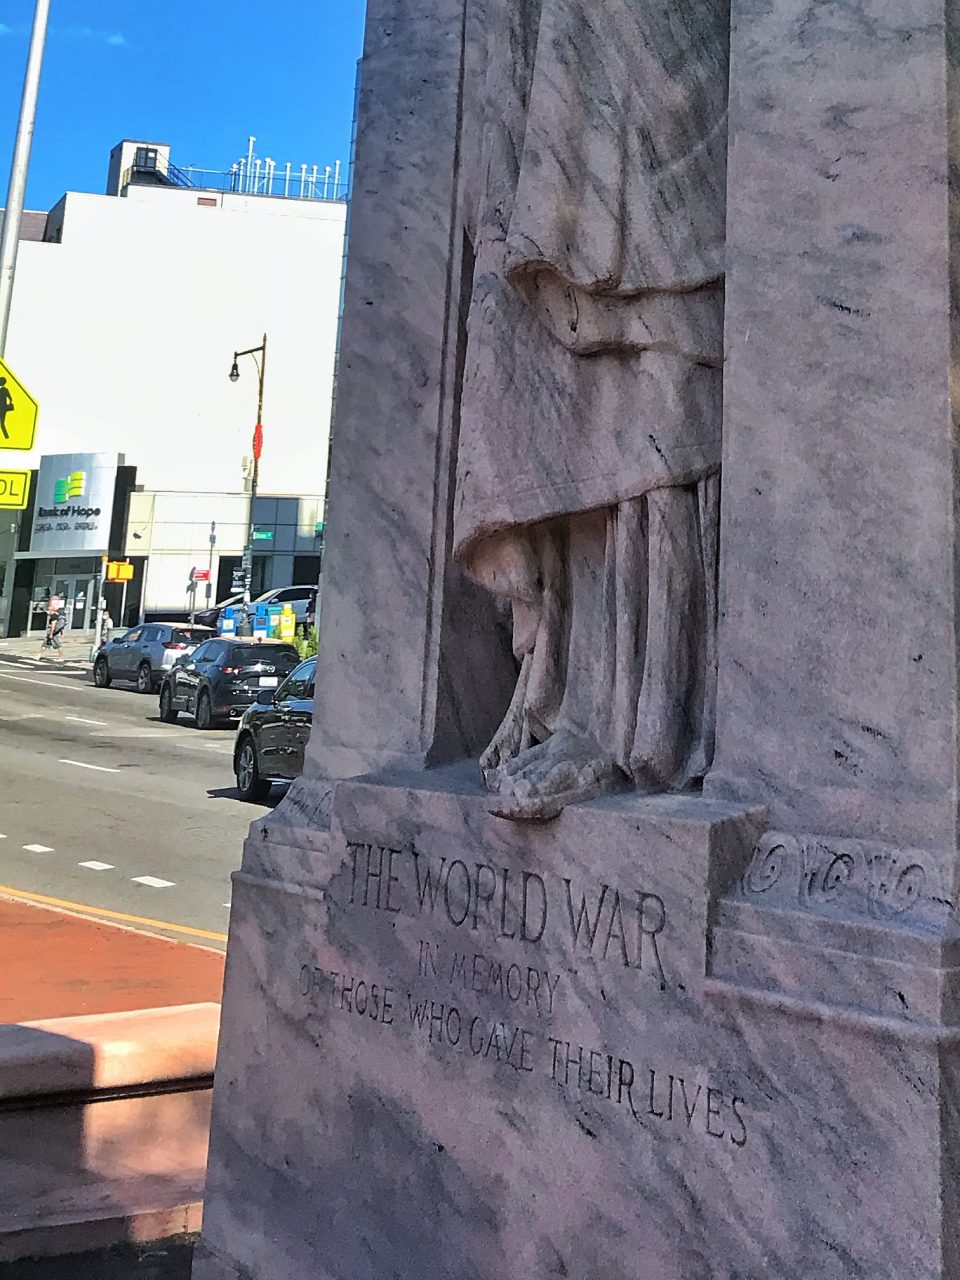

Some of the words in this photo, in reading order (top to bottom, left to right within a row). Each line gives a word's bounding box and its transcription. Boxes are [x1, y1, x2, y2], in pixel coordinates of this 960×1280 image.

[71, 506, 101, 519] Hope
[346, 841, 402, 913] THE
[411, 847, 548, 944] WORLD
[562, 877, 672, 991] WAR
[418, 939, 439, 976] IN
[449, 951, 560, 1016] MEMORY
[299, 963, 327, 998] OF
[330, 971, 394, 1025] THOSE
[406, 992, 463, 1046] WHO
[468, 1015, 534, 1072] GAVE
[549, 1036, 640, 1121] THEIR
[649, 1069, 749, 1148] LIVES
